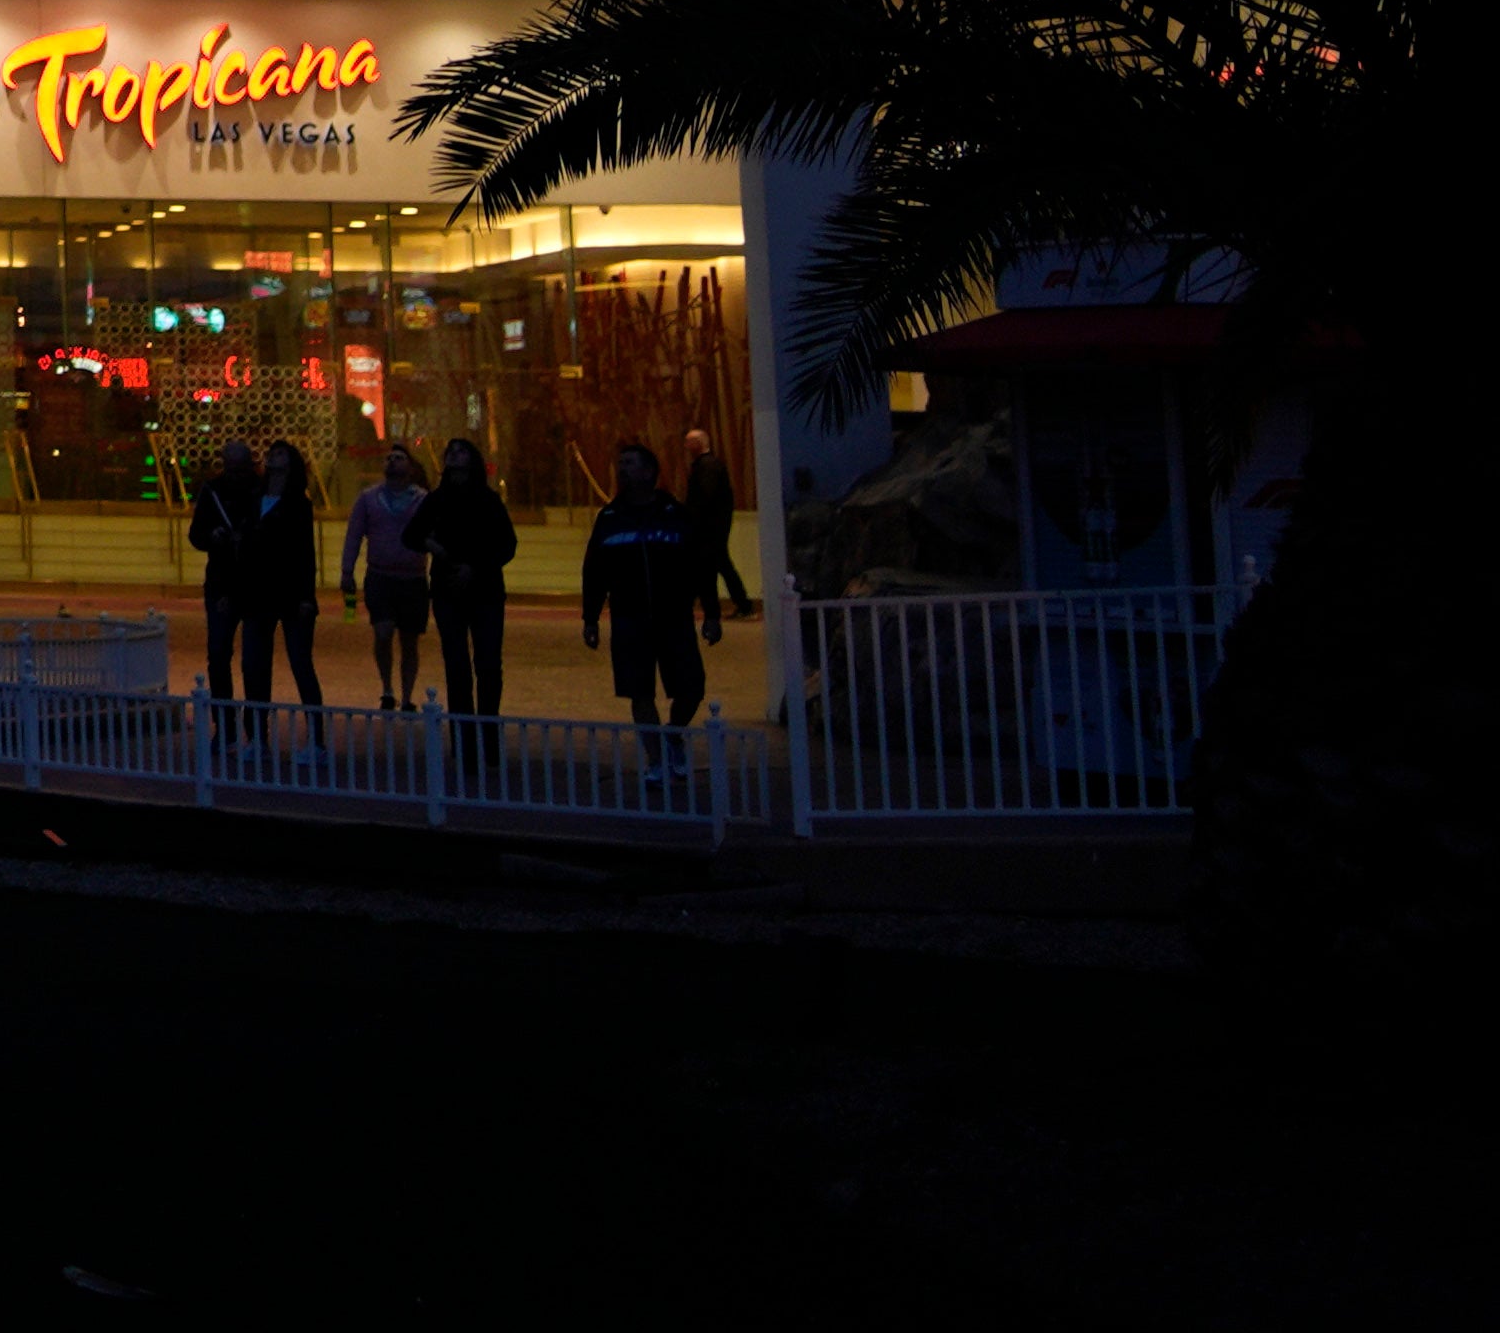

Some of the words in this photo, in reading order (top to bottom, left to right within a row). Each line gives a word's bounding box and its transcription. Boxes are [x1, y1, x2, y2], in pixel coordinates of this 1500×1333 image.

[1, 22, 381, 164] Tropicana
[192, 122, 240, 145] LAS
[258, 122, 357, 147] VEGAS
